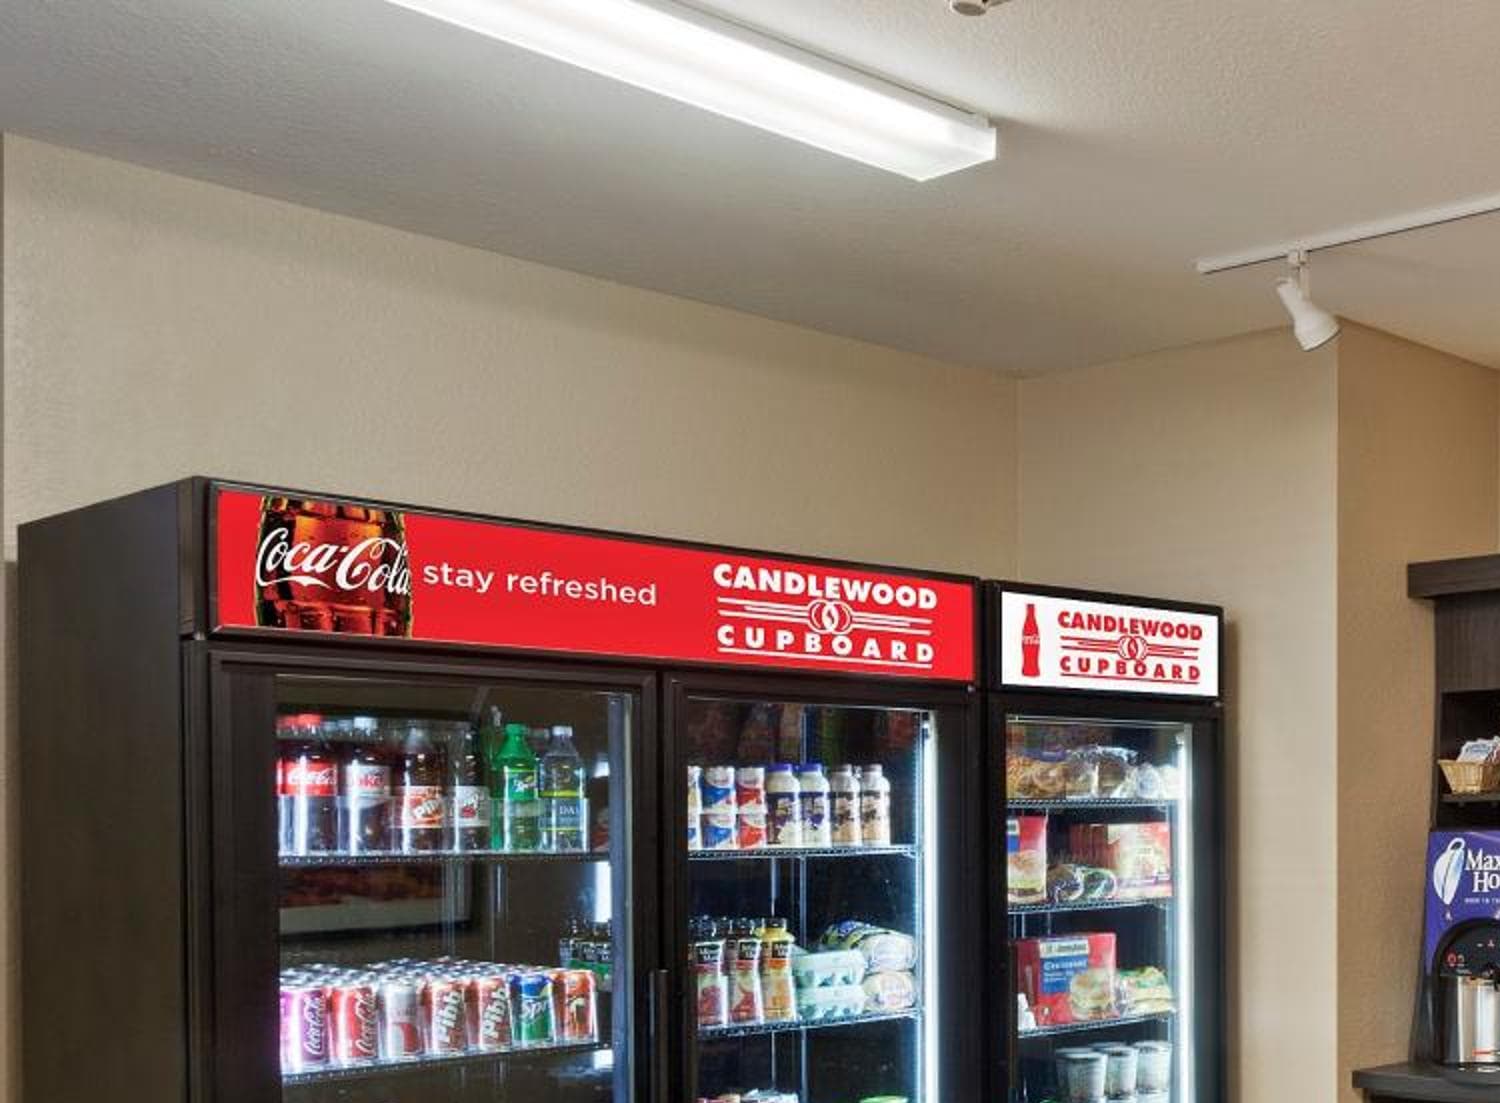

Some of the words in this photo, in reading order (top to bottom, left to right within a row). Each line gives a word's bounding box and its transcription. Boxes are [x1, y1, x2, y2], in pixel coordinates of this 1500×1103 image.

[256, 527, 411, 596] Coca-Cola
[423, 564, 494, 594] stay
[507, 571, 657, 608] refreshed
[713, 563, 938, 610] CANDLEWOOD
[717, 624, 934, 663] CUPBOARD
[1057, 610, 1203, 641] CANDLEWOOD
[1059, 655, 1200, 681] CUPBOARD
